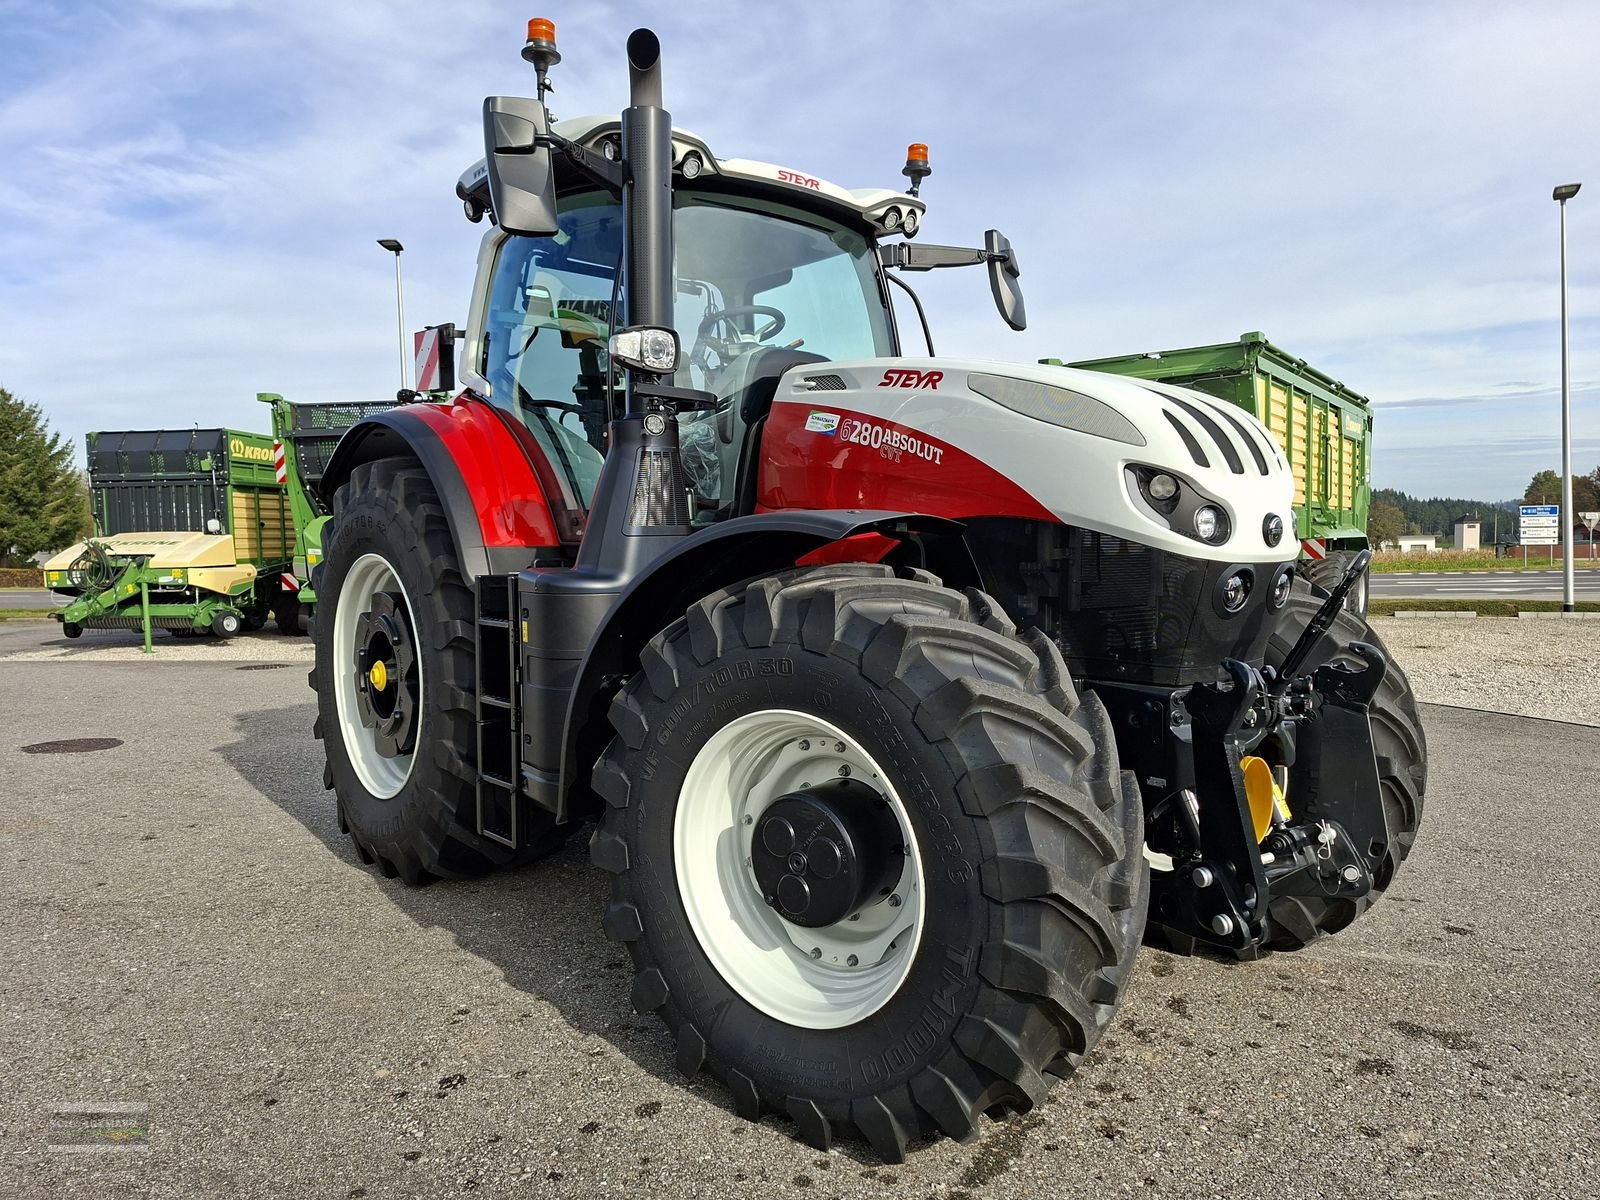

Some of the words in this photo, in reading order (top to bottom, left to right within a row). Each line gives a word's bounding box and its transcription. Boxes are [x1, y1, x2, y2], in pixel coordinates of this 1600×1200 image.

[778, 170, 820, 190] STEYR
[877, 368, 944, 390] STEYR
[840, 418, 883, 449] 6280
[881, 428, 944, 465] ABSOLUT
[245, 446, 275, 461] KRON
[879, 444, 902, 463] CVT
[735, 659, 755, 681] R
[758, 657, 794, 677] 30
[860, 943, 974, 1086] TM1000
